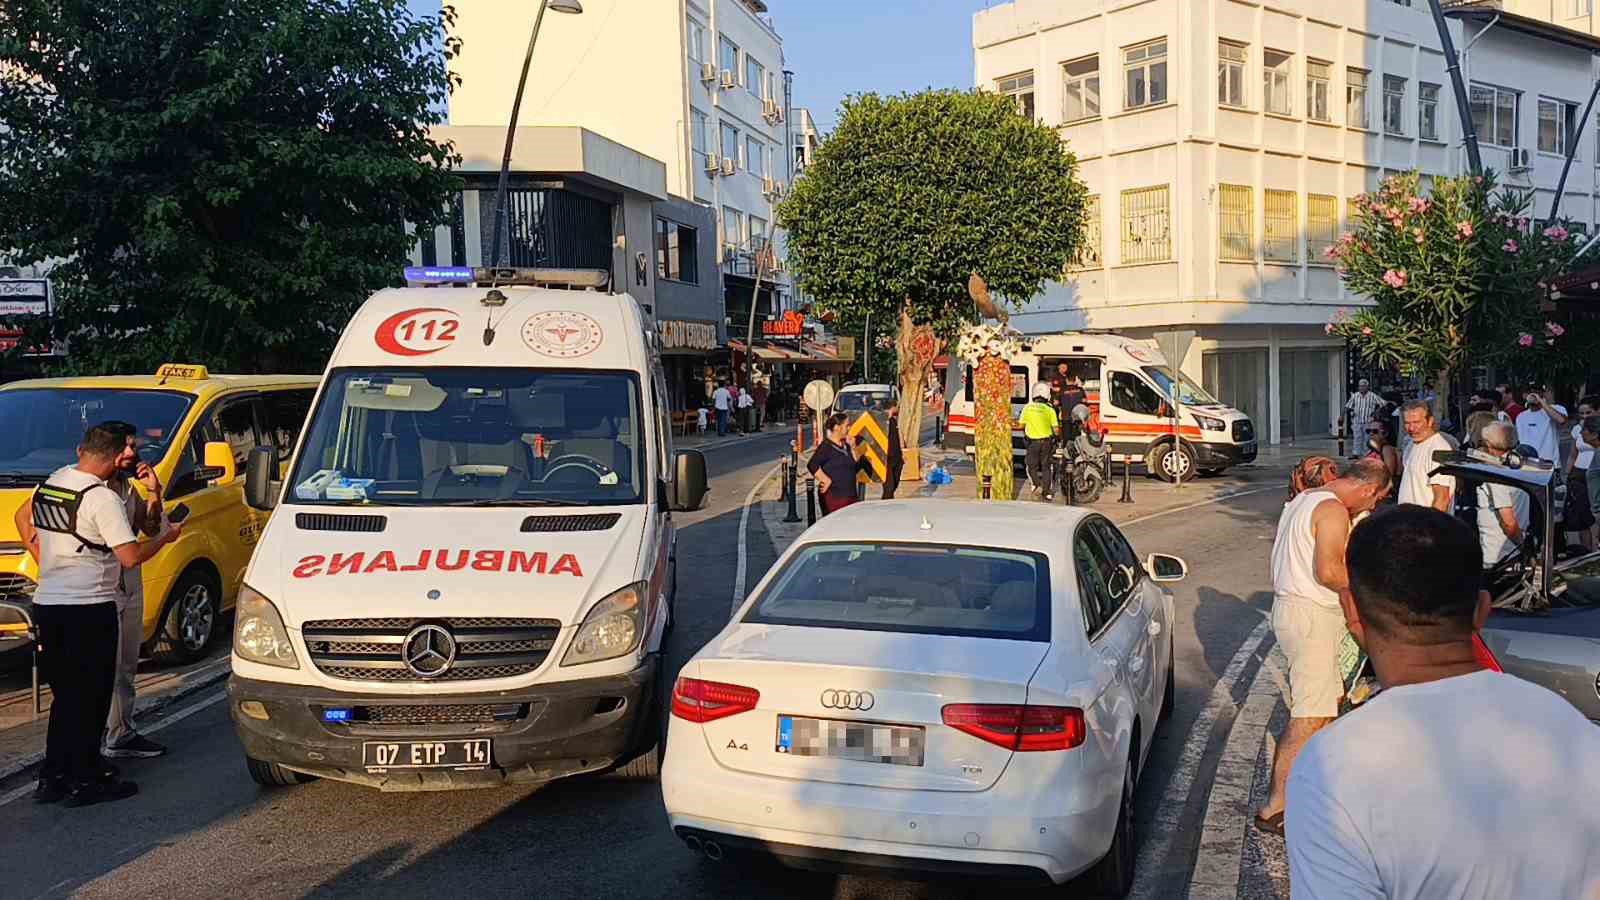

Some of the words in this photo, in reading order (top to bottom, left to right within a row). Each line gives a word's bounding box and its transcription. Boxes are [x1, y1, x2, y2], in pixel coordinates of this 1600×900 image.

[400, 319, 460, 341] 112
[376, 744, 399, 765] 07
[410, 743, 446, 764] ETP
[463, 742, 484, 762] 14
